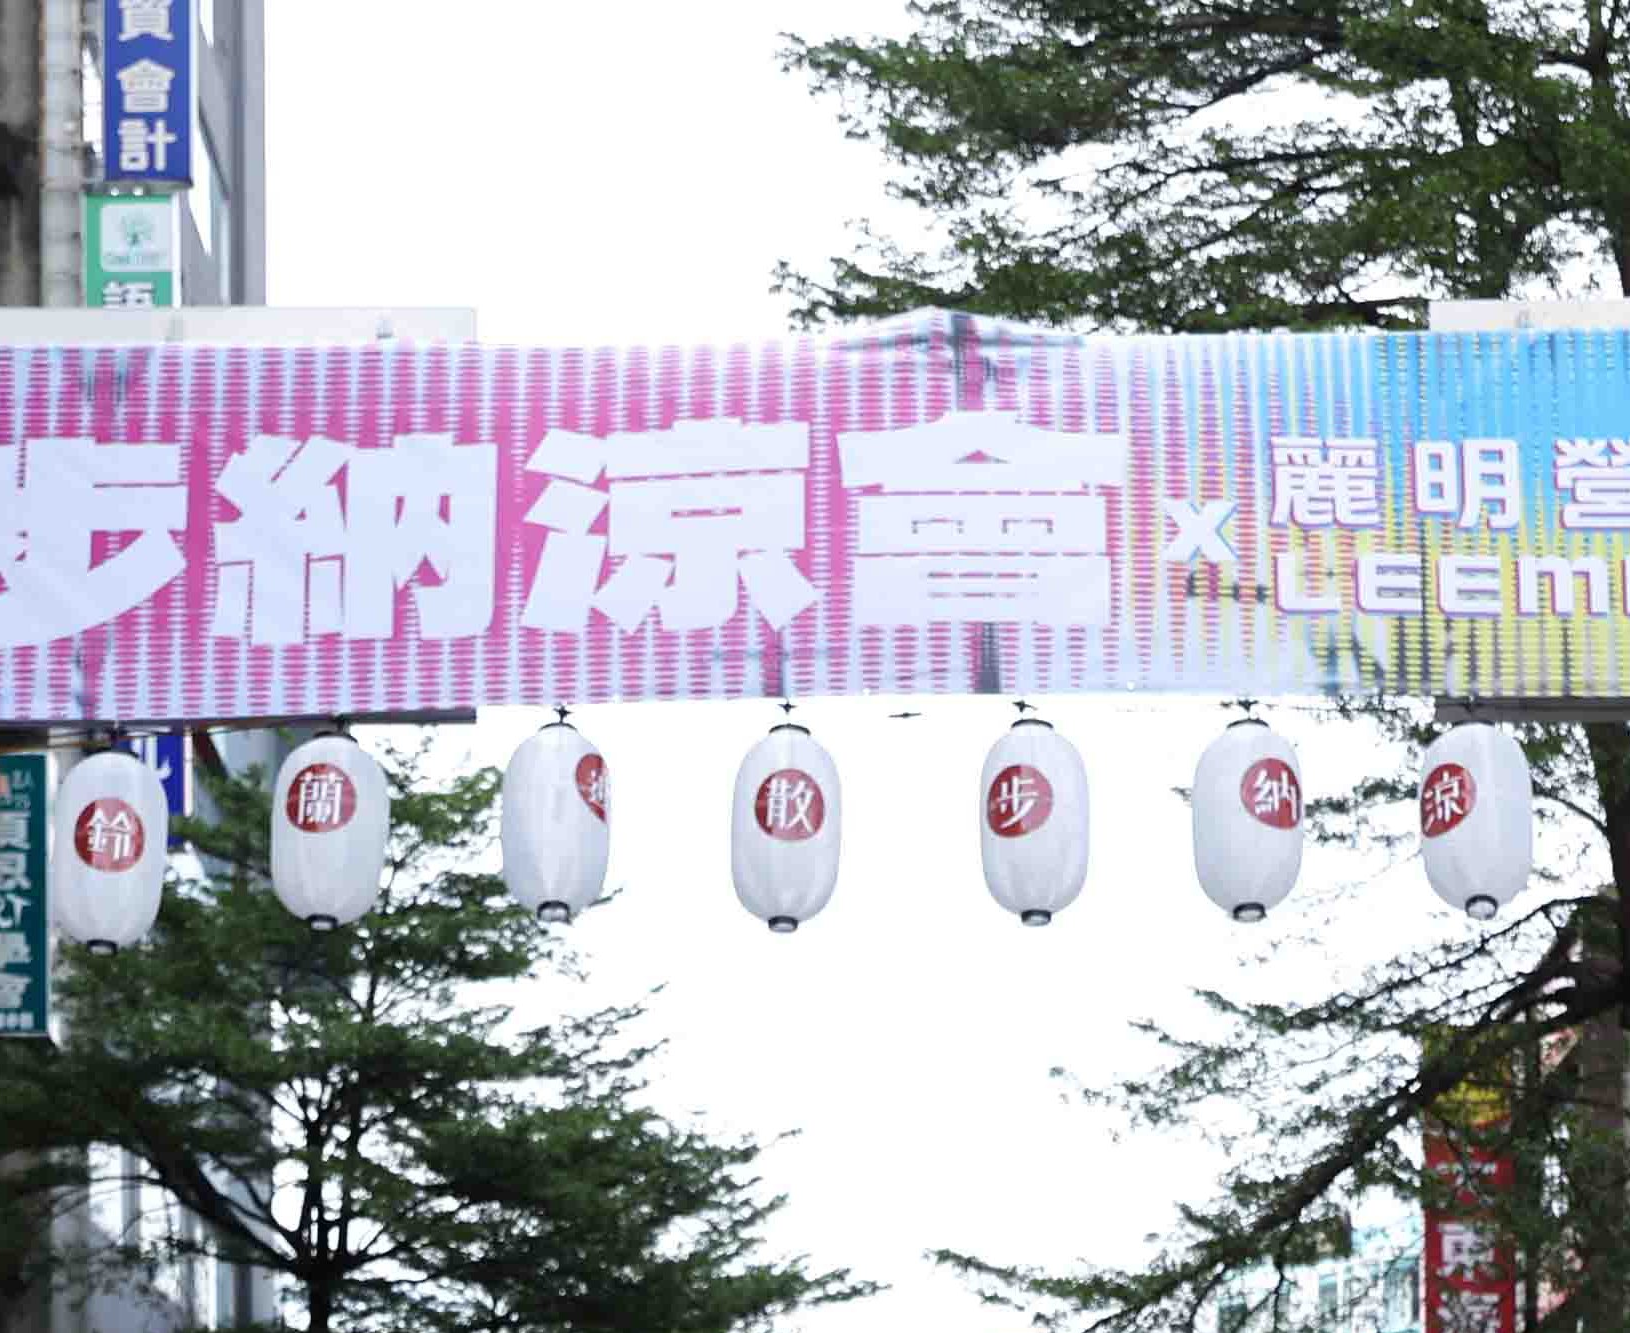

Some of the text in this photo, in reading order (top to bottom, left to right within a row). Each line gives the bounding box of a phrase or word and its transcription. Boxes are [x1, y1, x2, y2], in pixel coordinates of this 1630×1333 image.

[297, 768, 344, 826] 蘭
[765, 778, 821, 838] 散
[994, 776, 1039, 830] 步
[1252, 772, 1301, 822] 納
[1424, 777, 1463, 829] 涼
[85, 807, 135, 861] 鈴
